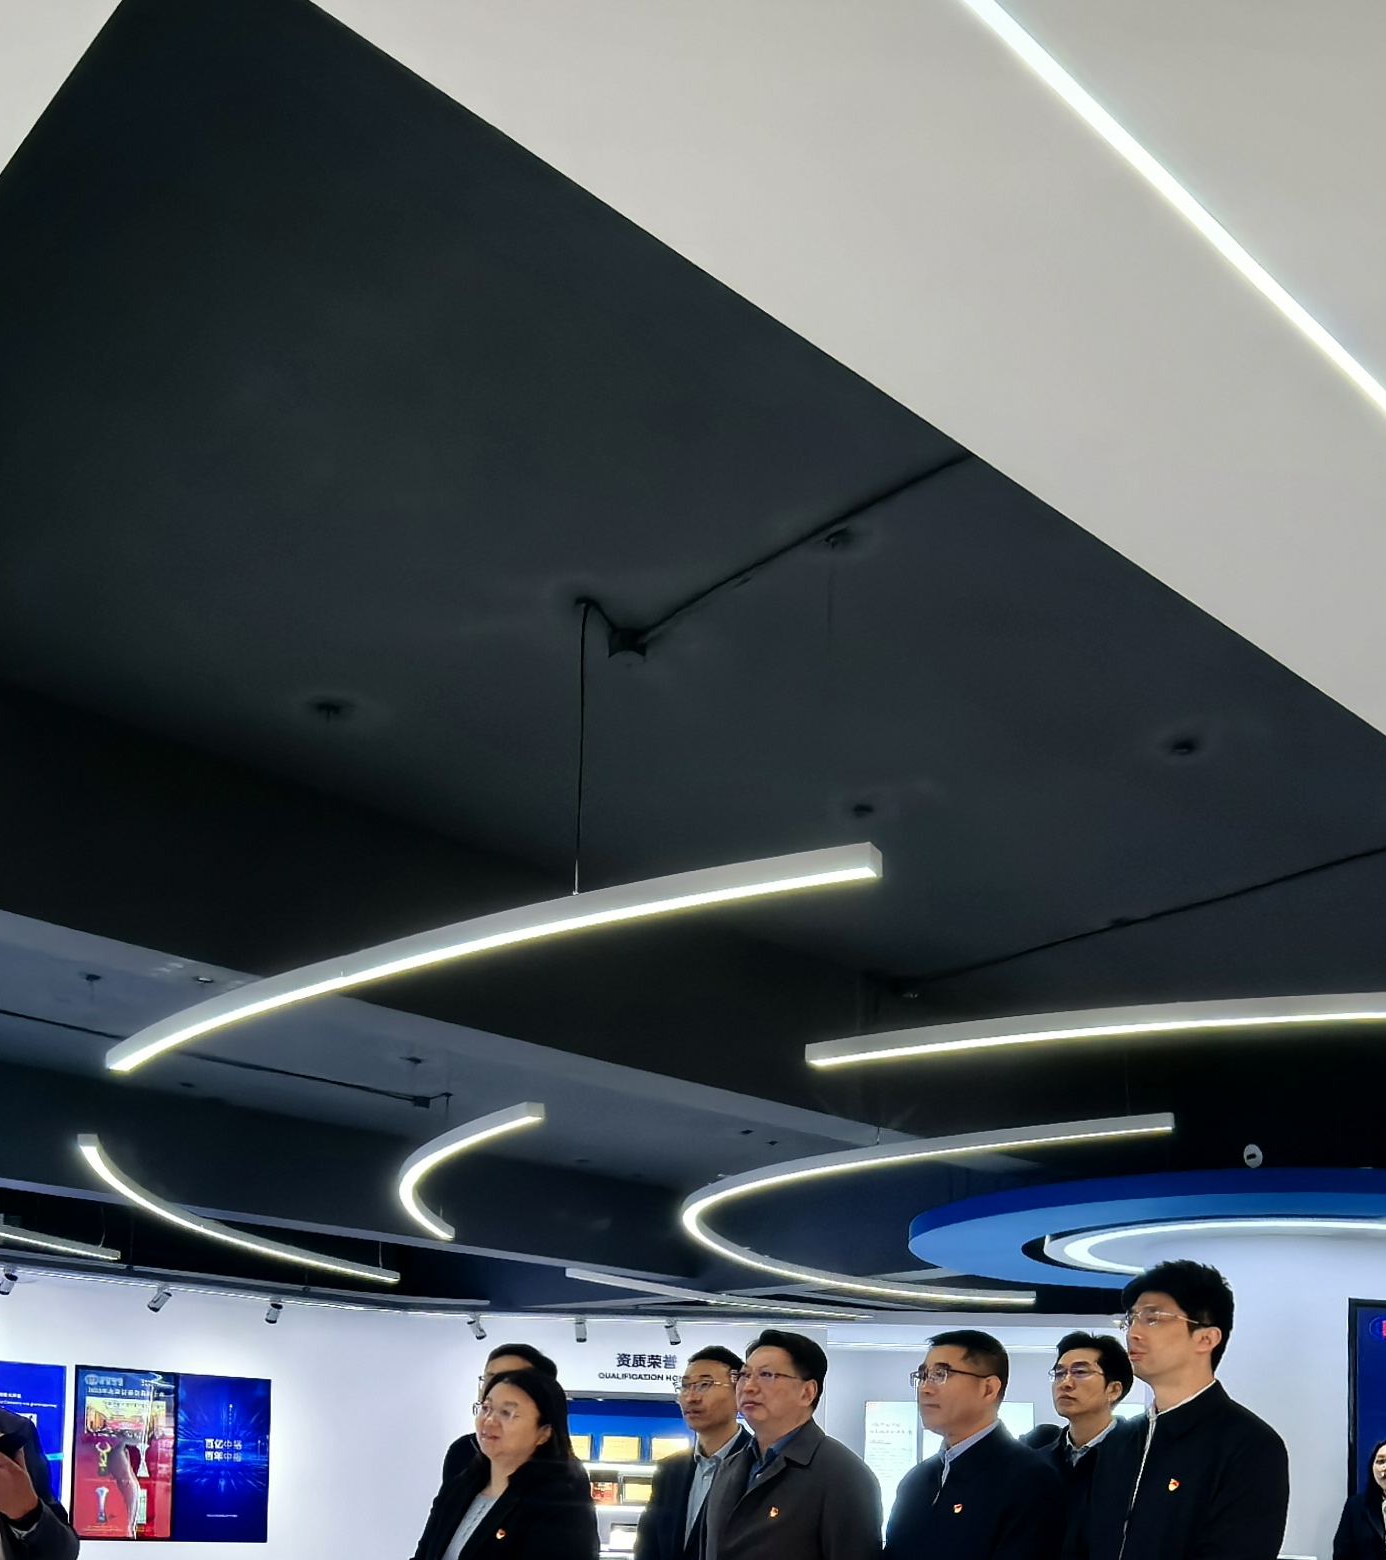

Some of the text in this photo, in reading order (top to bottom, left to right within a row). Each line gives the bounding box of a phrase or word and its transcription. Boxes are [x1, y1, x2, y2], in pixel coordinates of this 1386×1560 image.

[616, 1353, 678, 1369] 资质荣誉
[598, 1372, 664, 1381] QUALIFICATION
